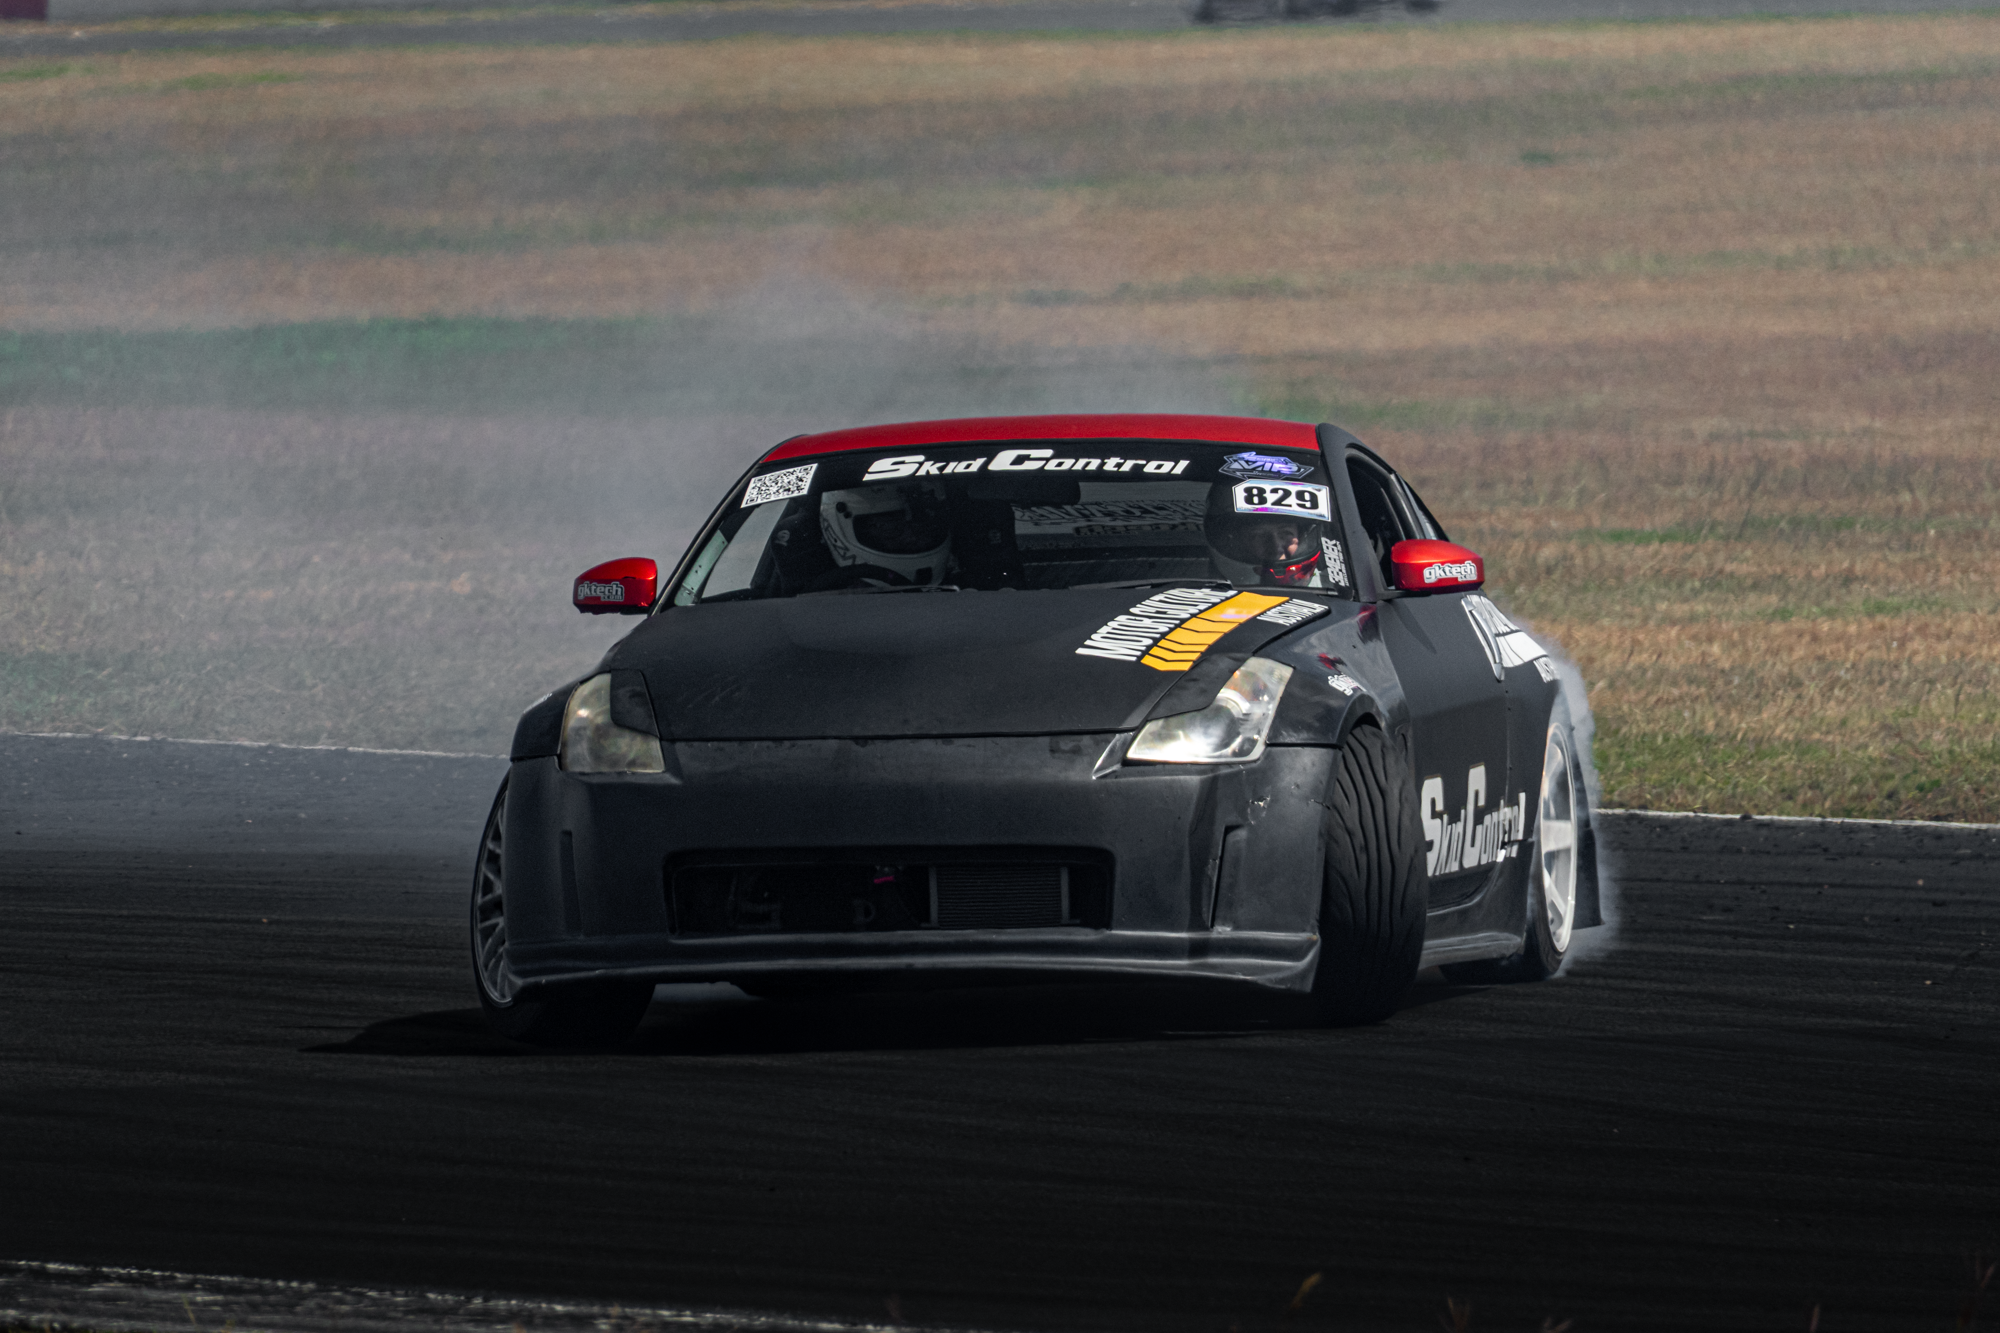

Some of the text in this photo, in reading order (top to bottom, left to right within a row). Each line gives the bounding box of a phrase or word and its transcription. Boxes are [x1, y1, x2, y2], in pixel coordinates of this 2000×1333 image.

[862, 449, 1190, 481] Skid Control
[1243, 486, 1320, 510] 829
[1424, 561, 1477, 583] gktech
[578, 581, 624, 600] gktech
[1075, 615, 1181, 661] MOTOR
[1421, 775, 1465, 877] Skid
